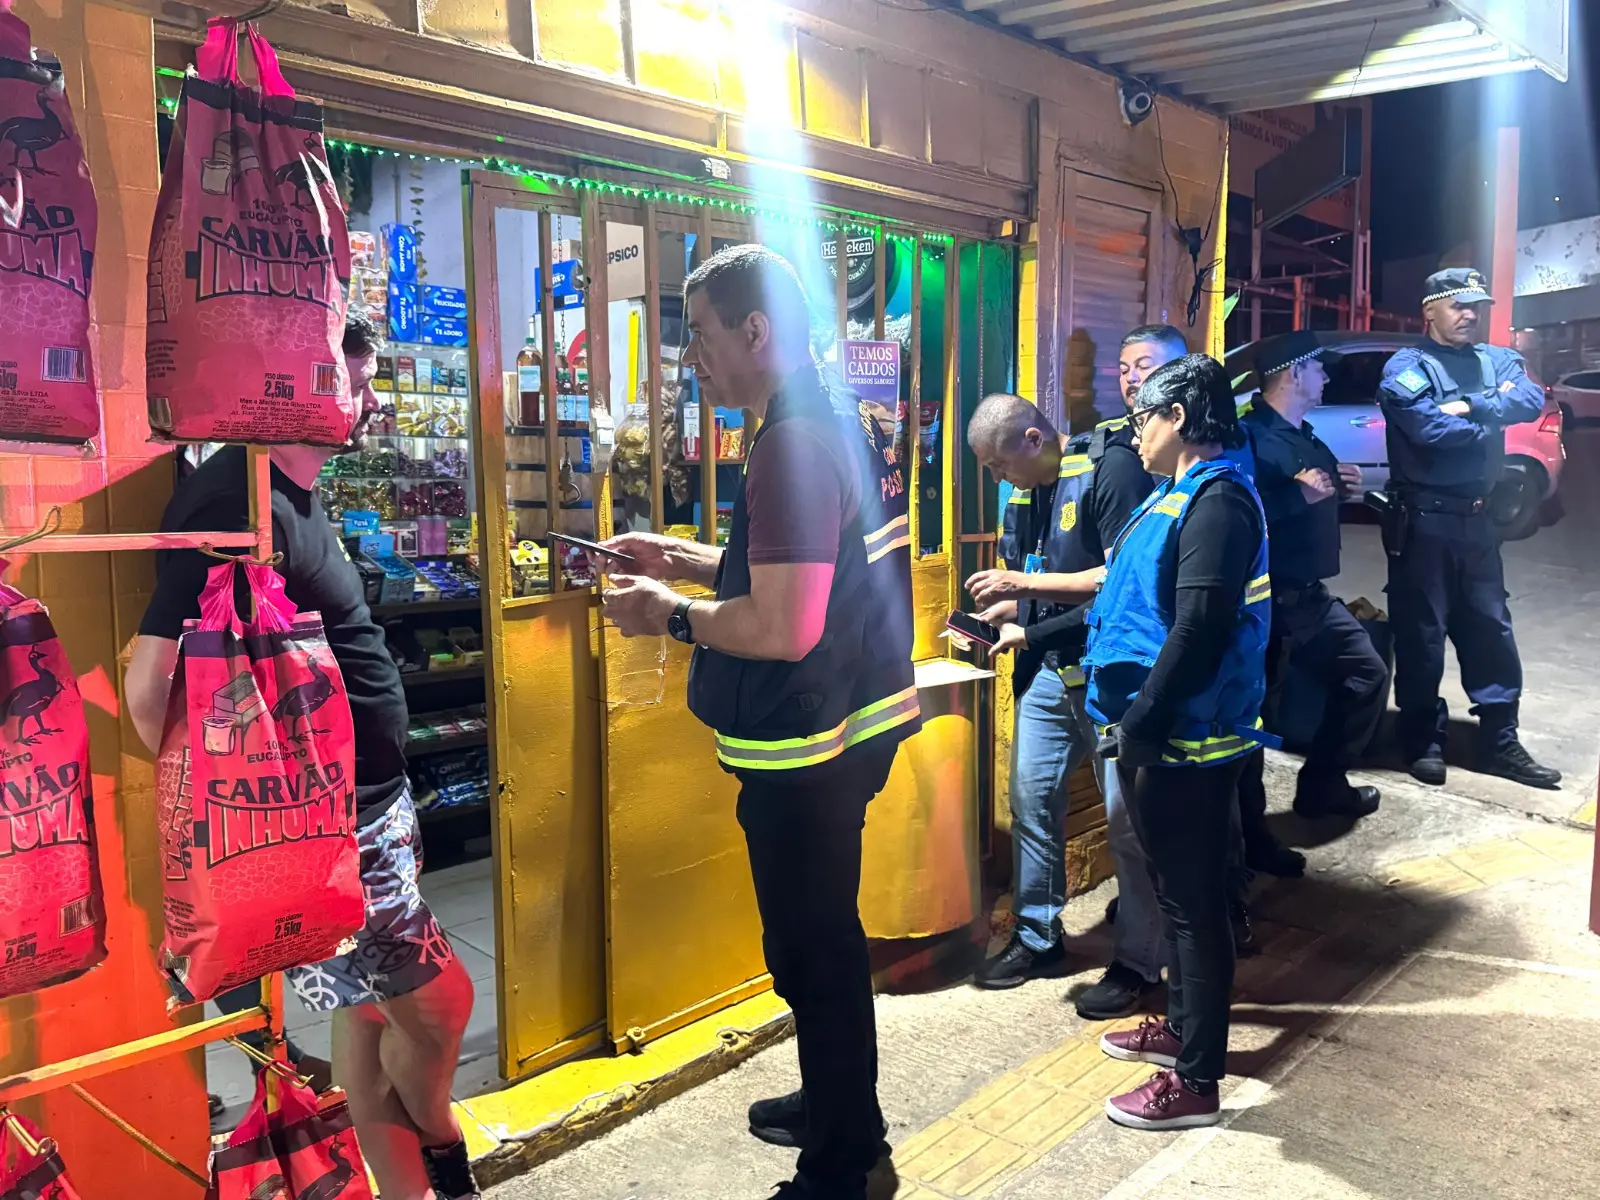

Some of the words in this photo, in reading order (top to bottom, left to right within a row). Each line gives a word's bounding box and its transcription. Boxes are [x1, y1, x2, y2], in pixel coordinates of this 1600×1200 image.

[202, 216, 334, 259] CARVÃO
[398, 235, 406, 252] COM
[606, 245, 639, 265] PSICO
[823, 241, 872, 256] Heeken
[400, 296, 406, 306] TE
[433, 299, 467, 309] FELICIDADES
[443, 328, 464, 337] ADORO
[849, 345, 893, 361] TEMOS
[848, 361, 896, 377] CALDOS
[848, 377, 873, 385] DIVERSOS
[873, 377, 895, 385] SABORES
[264, 380, 295, 400] 2,5kg
[207, 760, 344, 804] CARVÃO
[206, 779, 349, 870] INHUMA
[274, 920, 302, 940] 2,5kg
